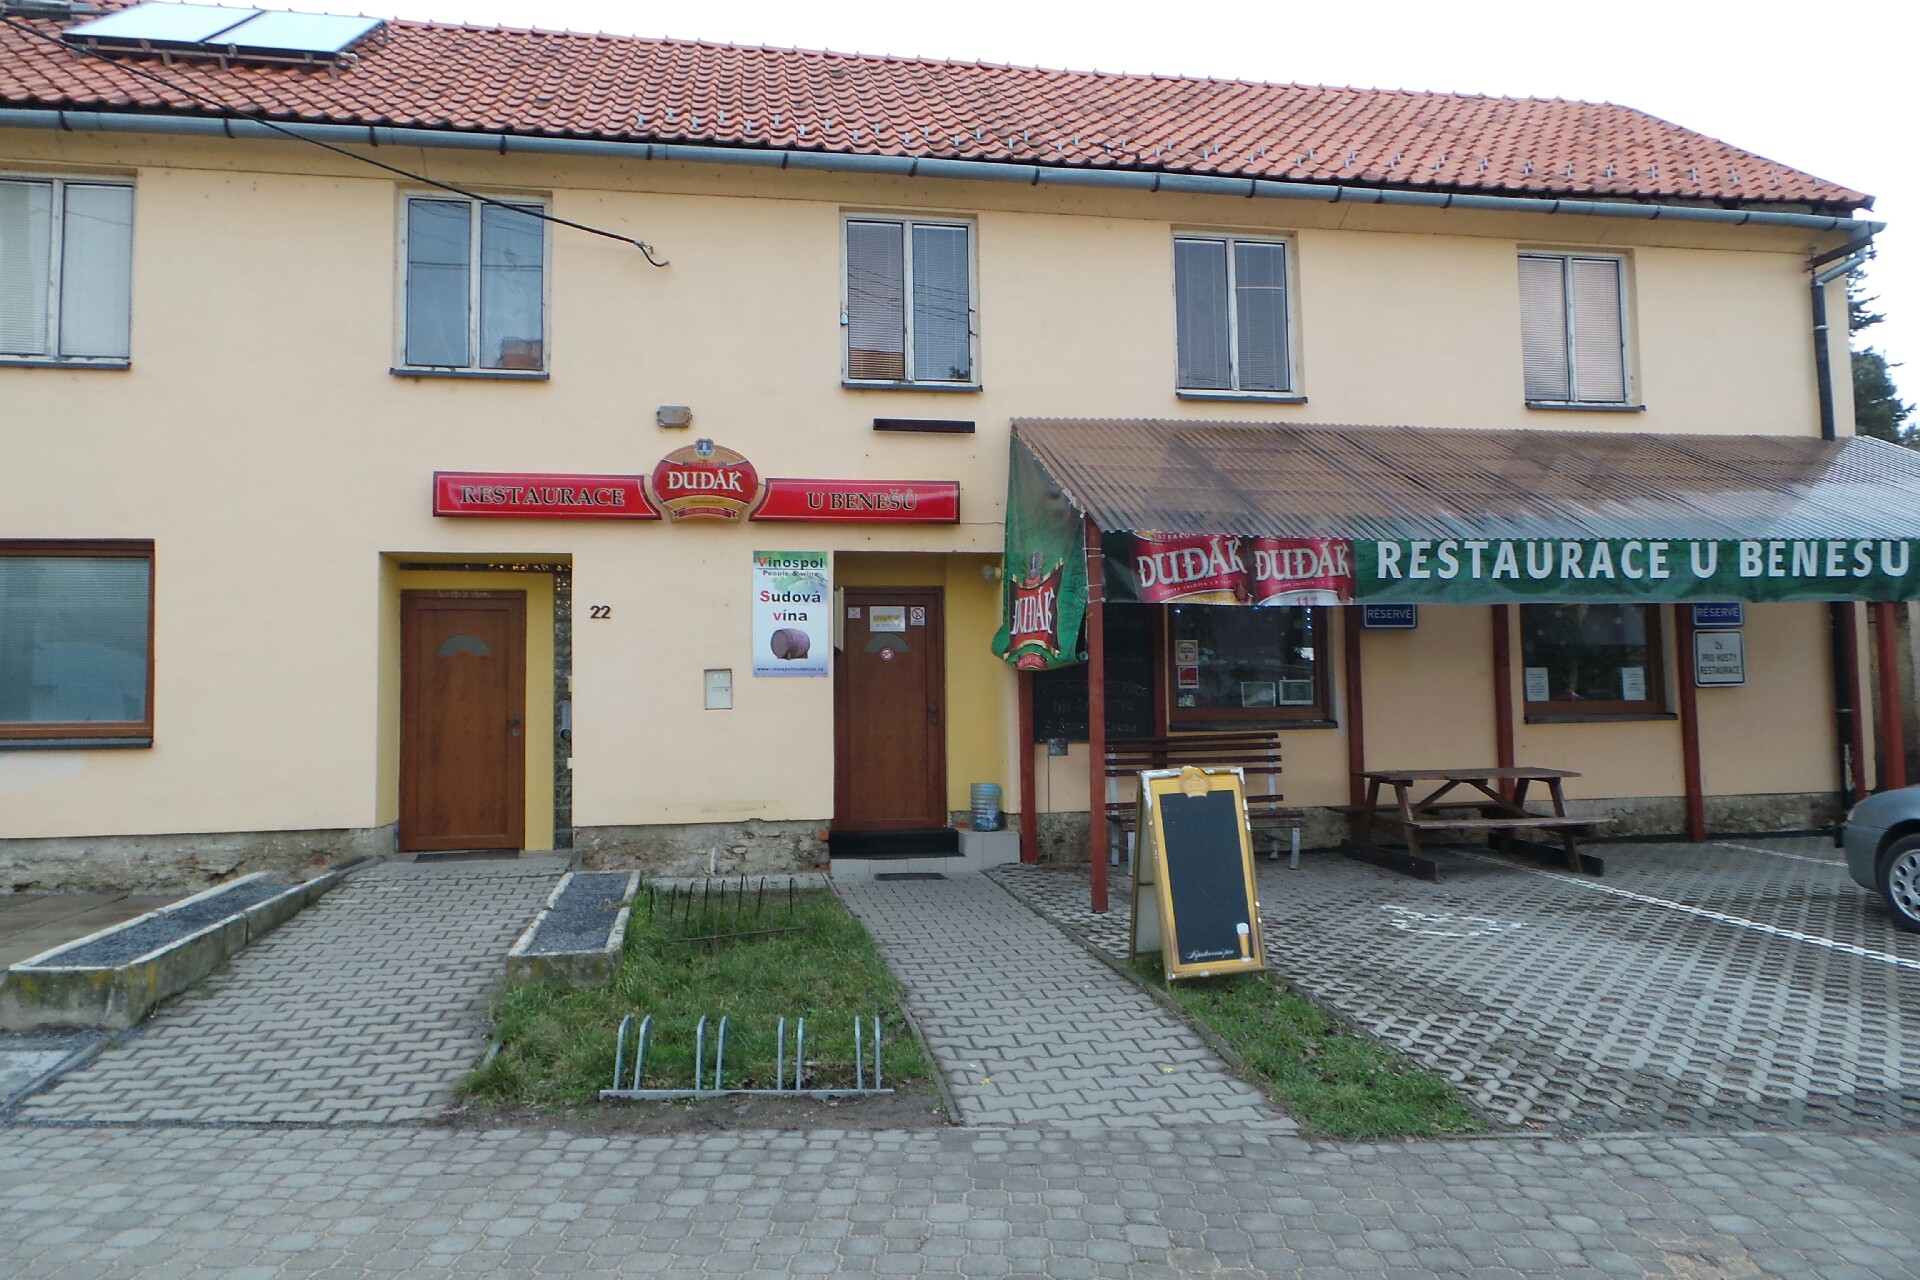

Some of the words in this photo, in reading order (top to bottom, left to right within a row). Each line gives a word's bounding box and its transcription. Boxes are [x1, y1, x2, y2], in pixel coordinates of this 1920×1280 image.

[460, 485, 625, 506] RESTAURACE
[807, 492, 824, 510] U
[829, 489, 918, 511] BENEŠŮ
[757, 556, 823, 570] Vinospol
[1377, 541, 1670, 579] RESTAURACE
[1690, 541, 1717, 579] U
[1739, 540, 1910, 578] BENESU
[760, 590, 821, 603] Sudová
[590, 605, 611, 620] 22
[773, 609, 808, 623] vína
